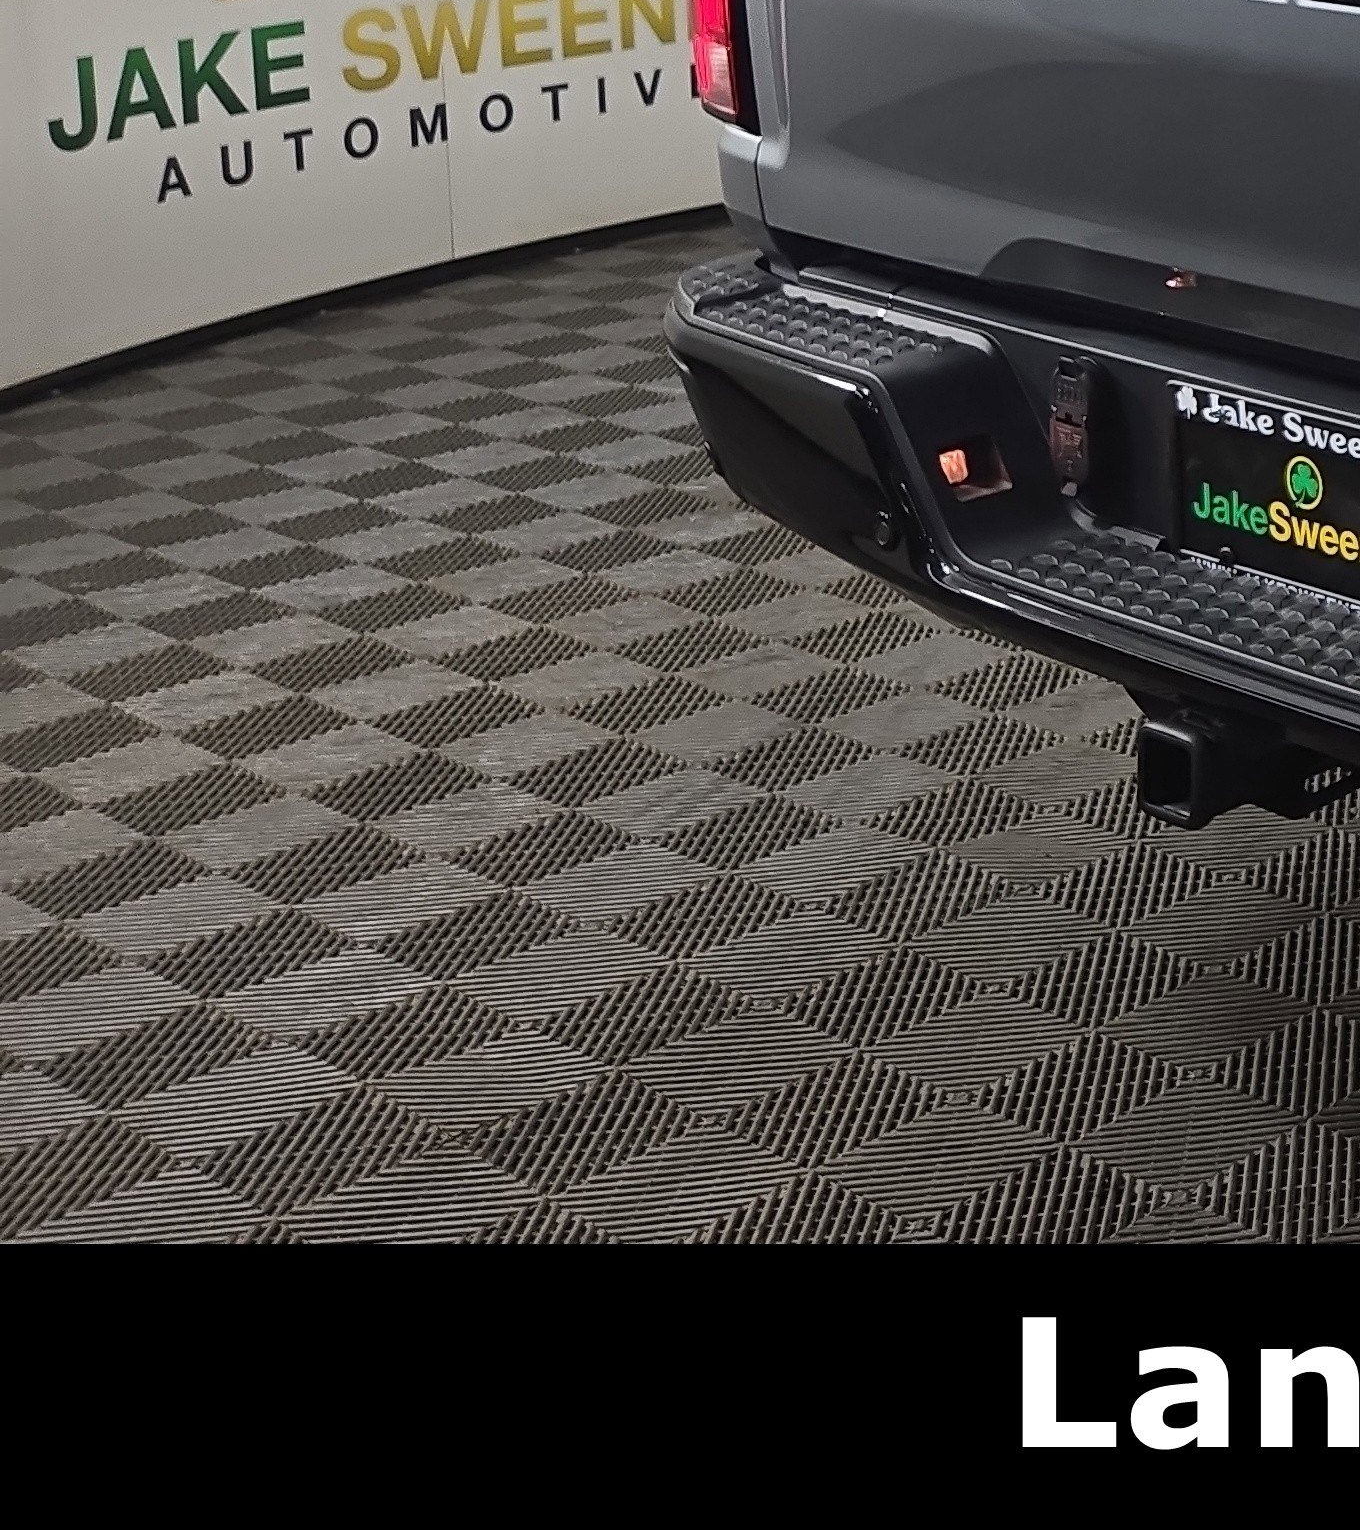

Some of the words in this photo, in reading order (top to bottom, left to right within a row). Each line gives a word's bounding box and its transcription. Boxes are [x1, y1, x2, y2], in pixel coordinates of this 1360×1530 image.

[48, 20, 311, 153] JAKE
[157, 62, 700, 203] AUTOMOTIV
[1202, 392, 1275, 436] Jake
